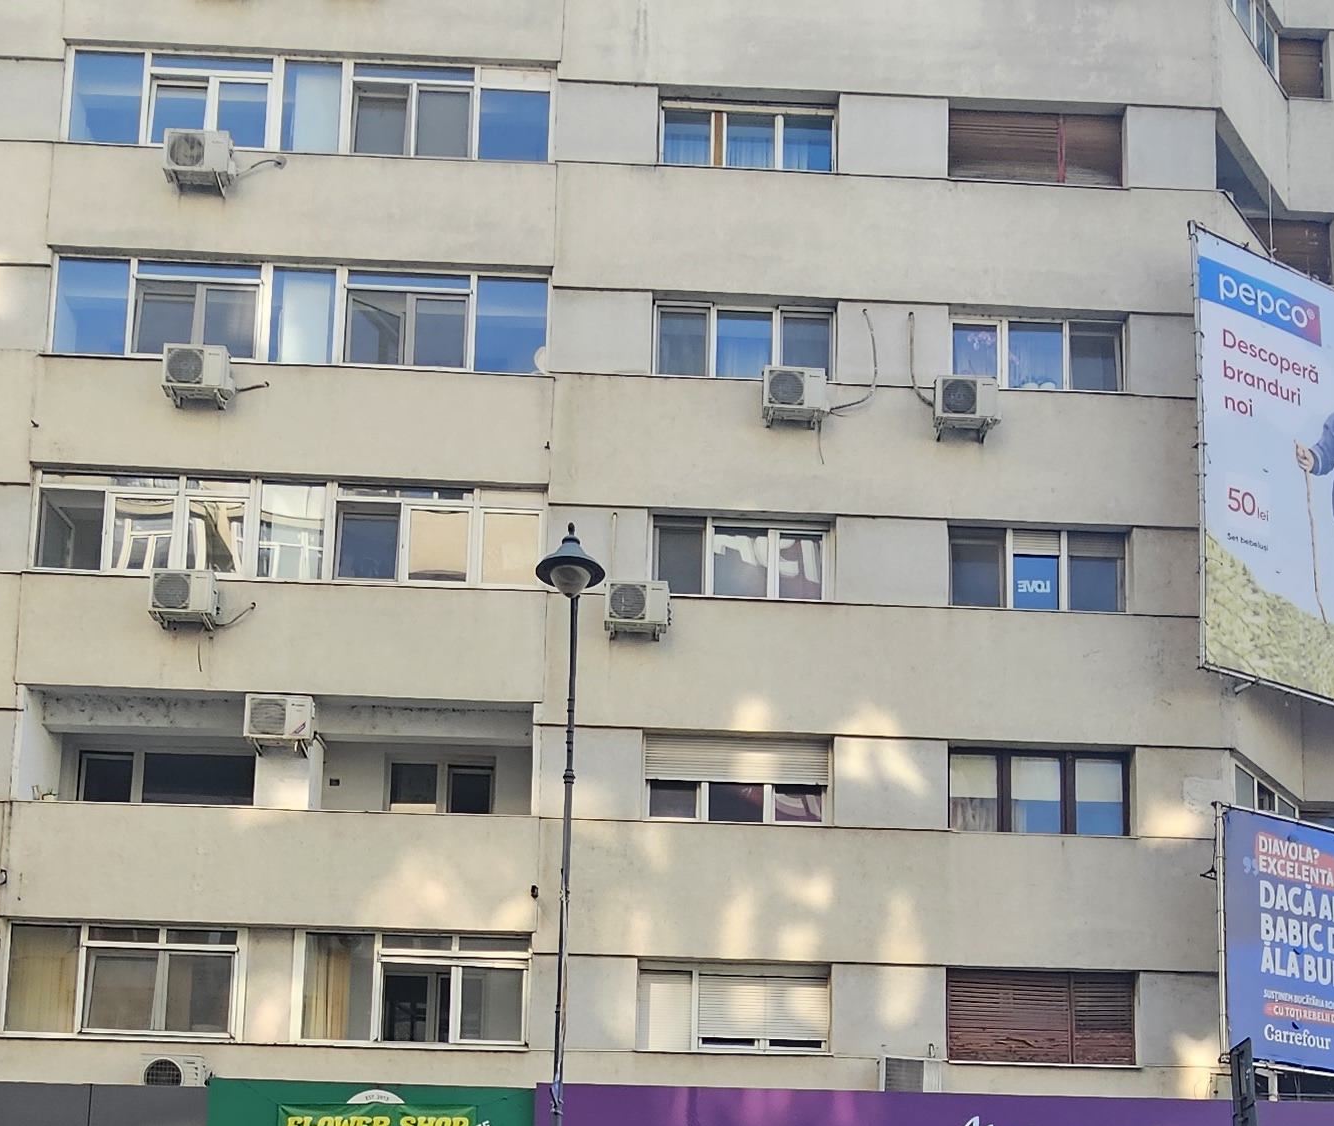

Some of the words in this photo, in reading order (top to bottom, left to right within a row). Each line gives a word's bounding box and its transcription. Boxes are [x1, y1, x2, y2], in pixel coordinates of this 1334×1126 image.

[1223, 328, 1319, 384] Descoperă
[1223, 360, 1301, 406] branduri
[1224, 395, 1253, 417] noi
[1228, 487, 1256, 516] 50
[1257, 507, 1269, 522] lei
[1258, 835, 1320, 864] DIAVOLA?
[1259, 880, 1316, 917] DACĂ
[1260, 913, 1324, 952] BABIC
[1260, 941, 1300, 979] ĂLA
[1273, 1005, 1284, 1015] CU
[1303, 1009, 1331, 1023] REBELII
[1264, 1024, 1331, 1050] Carrefour
